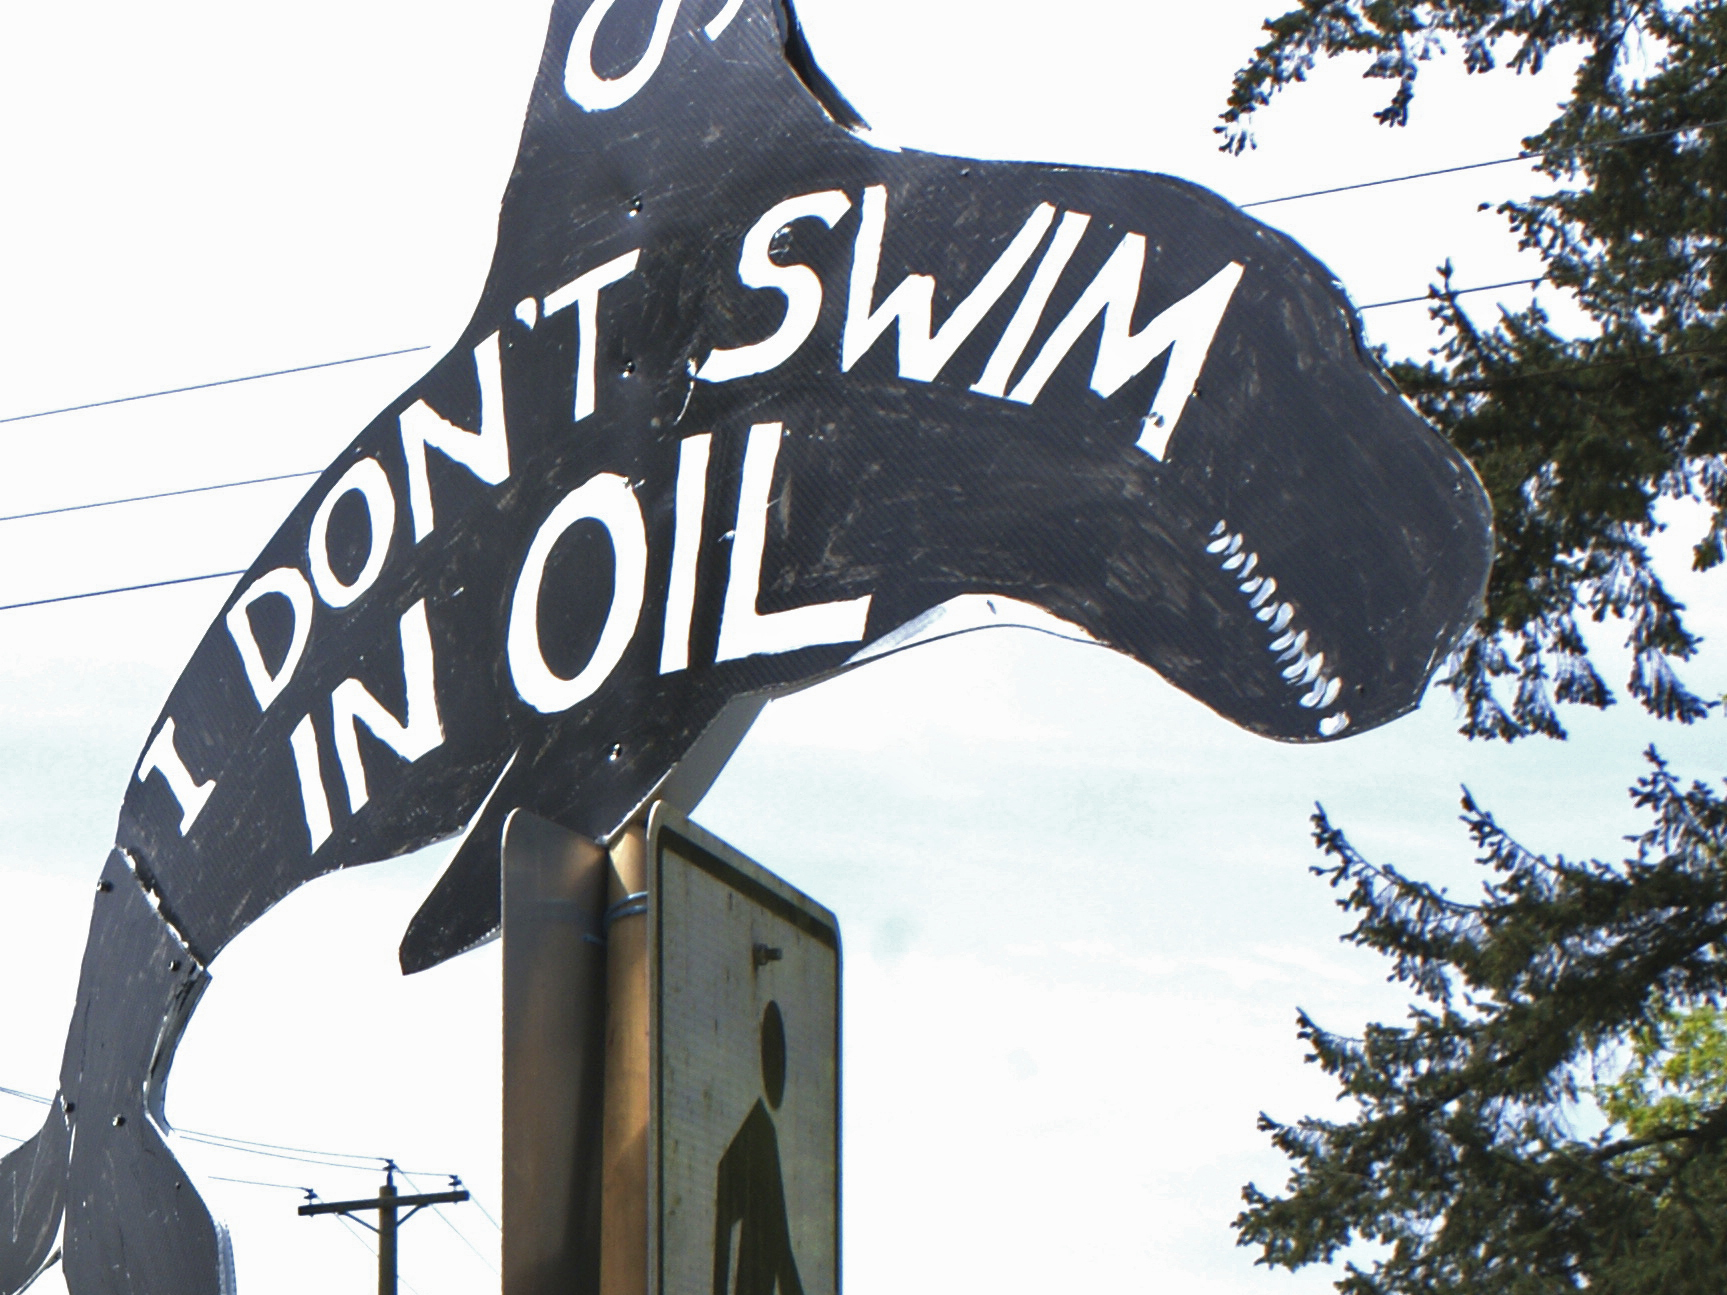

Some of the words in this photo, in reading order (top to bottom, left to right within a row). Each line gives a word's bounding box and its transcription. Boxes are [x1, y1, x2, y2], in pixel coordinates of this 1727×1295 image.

[140, 717, 216, 834] I
[228, 250, 639, 711] DON'T
[695, 184, 1243, 462] SWIM
[291, 600, 443, 853] IN
[507, 423, 871, 714] OIL
